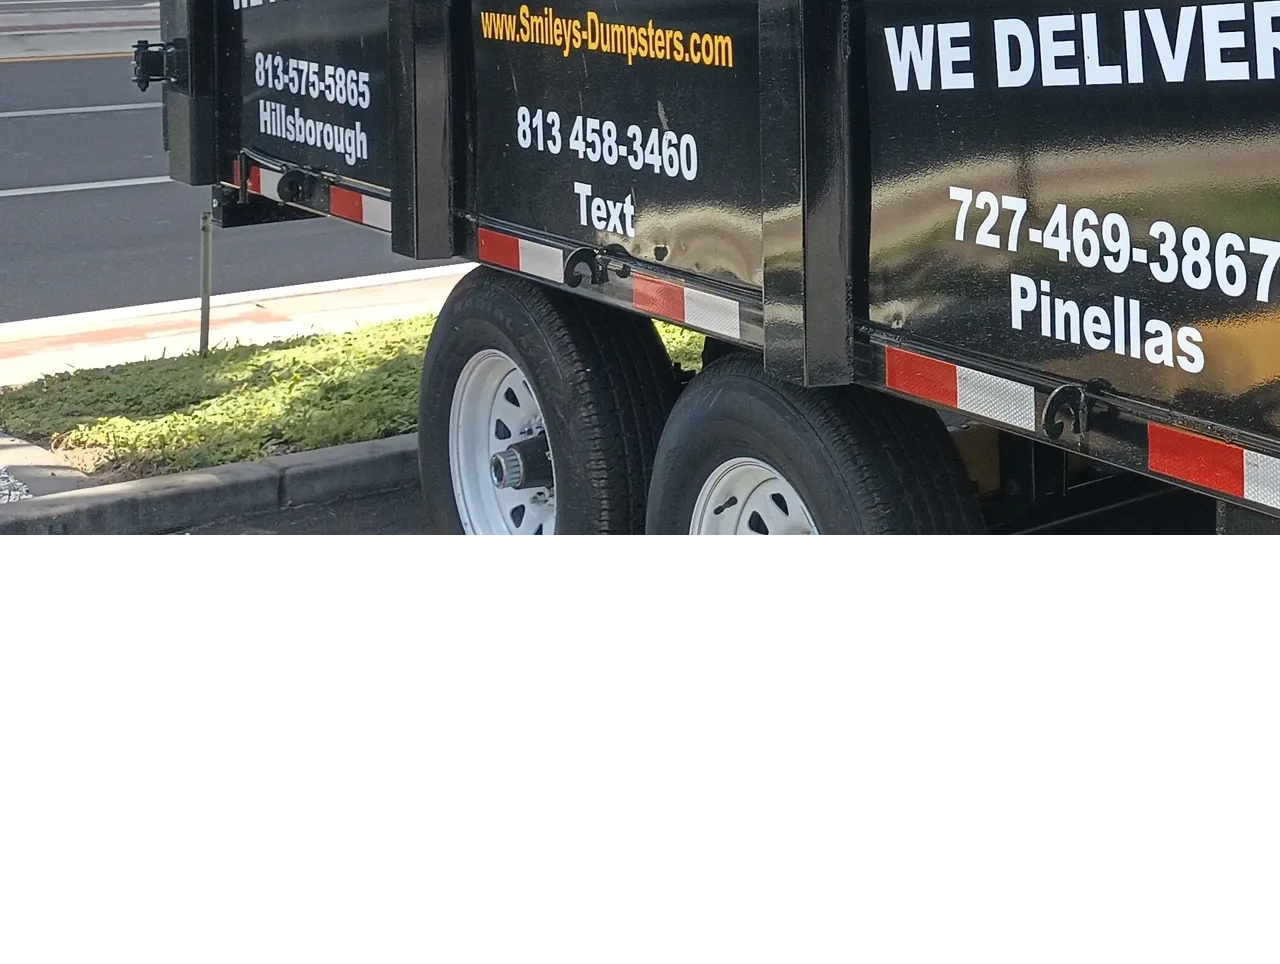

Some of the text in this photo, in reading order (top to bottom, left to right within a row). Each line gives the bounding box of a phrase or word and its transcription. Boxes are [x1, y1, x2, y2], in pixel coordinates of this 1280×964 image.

[480, 4, 734, 68] www.Smileys-Dumpsters.com
[884, 21, 975, 92] WE
[254, 51, 371, 110] 813-575-5865
[258, 99, 369, 166] Hillsborough
[516, 106, 698, 181] 813 458-3460
[573, 181, 635, 237] Text
[1009, 273, 1206, 375] Pinellas
